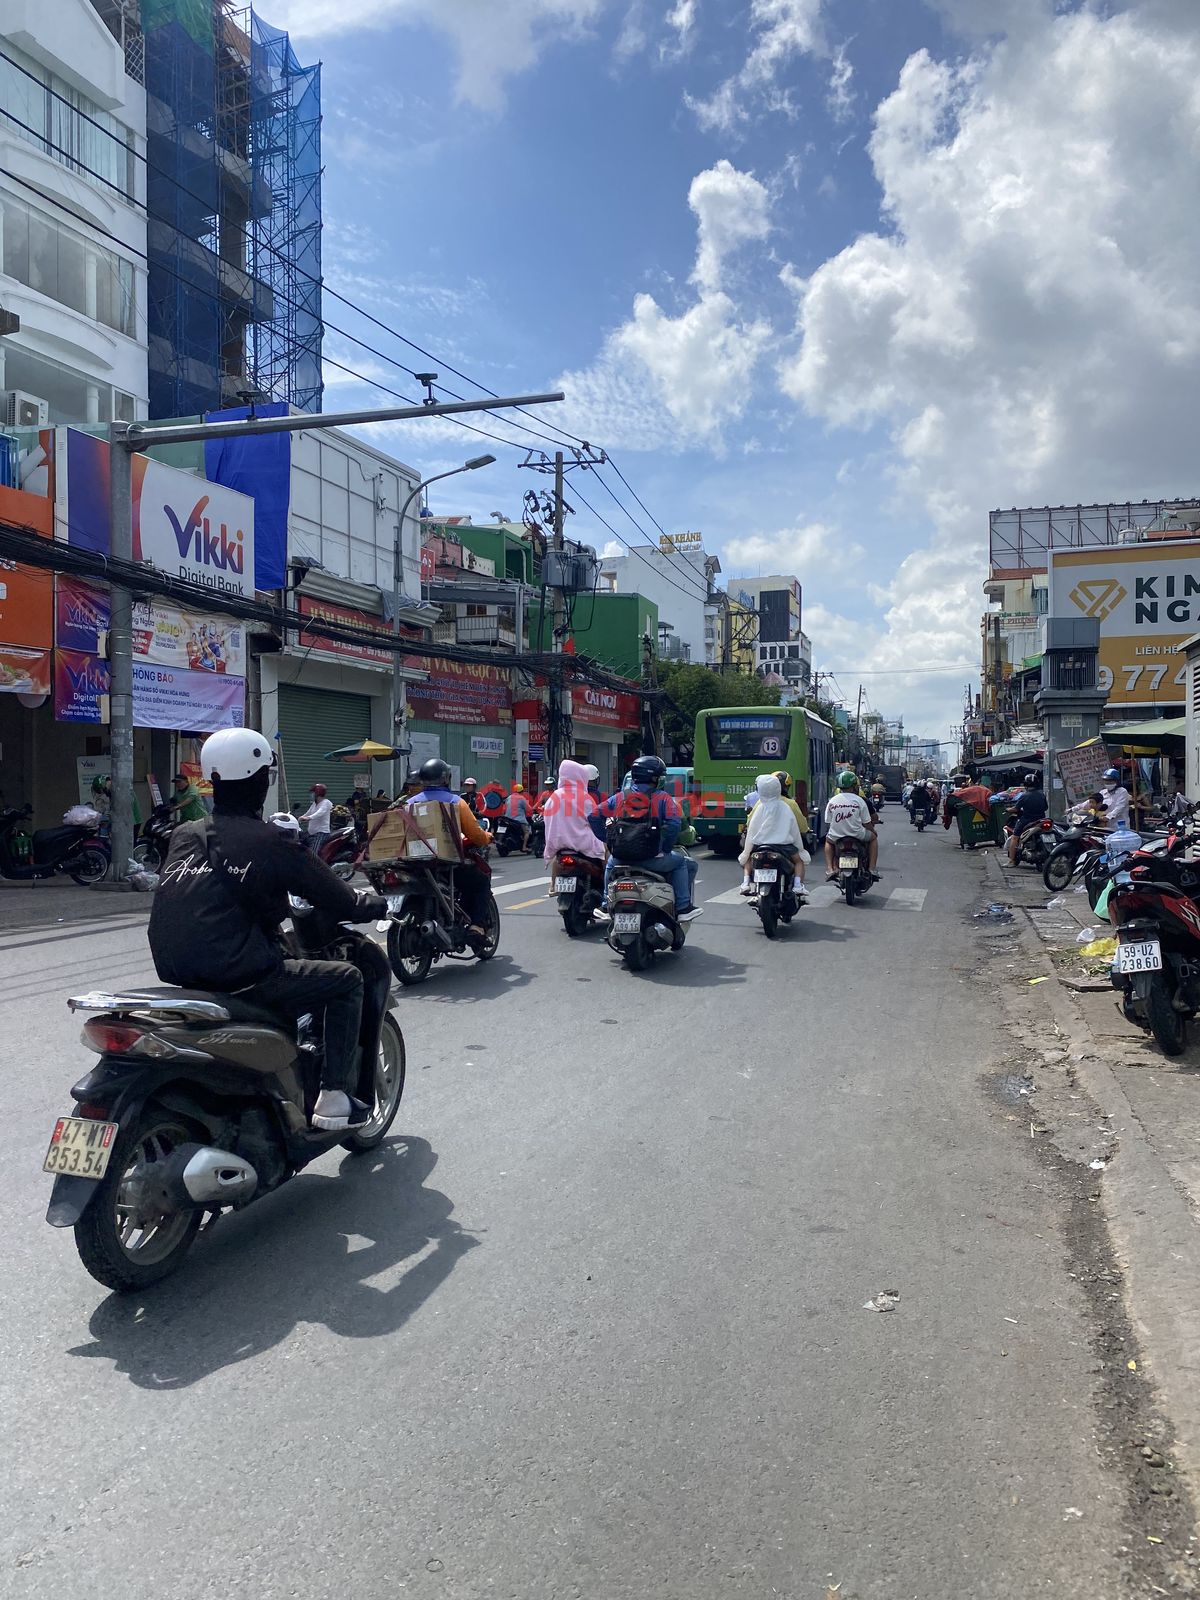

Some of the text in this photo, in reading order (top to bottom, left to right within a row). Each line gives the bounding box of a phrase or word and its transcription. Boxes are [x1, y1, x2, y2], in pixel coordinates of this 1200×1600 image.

[163, 495, 244, 575] Vikki
[217, 576, 244, 596] Bank
[1135, 600, 1200, 624] NG
[1135, 645, 1161, 656] LIÊN
[132, 667, 156, 681] HÔNG
[765, 742, 777, 751] 13
[726, 784, 756, 795] 51B-30
[1124, 944, 1154, 958] 59-U2
[1121, 956, 1159, 971] 238.60
[62, 1121, 107, 1149] 47-M1
[47, 1146, 104, 1176] 353.54
